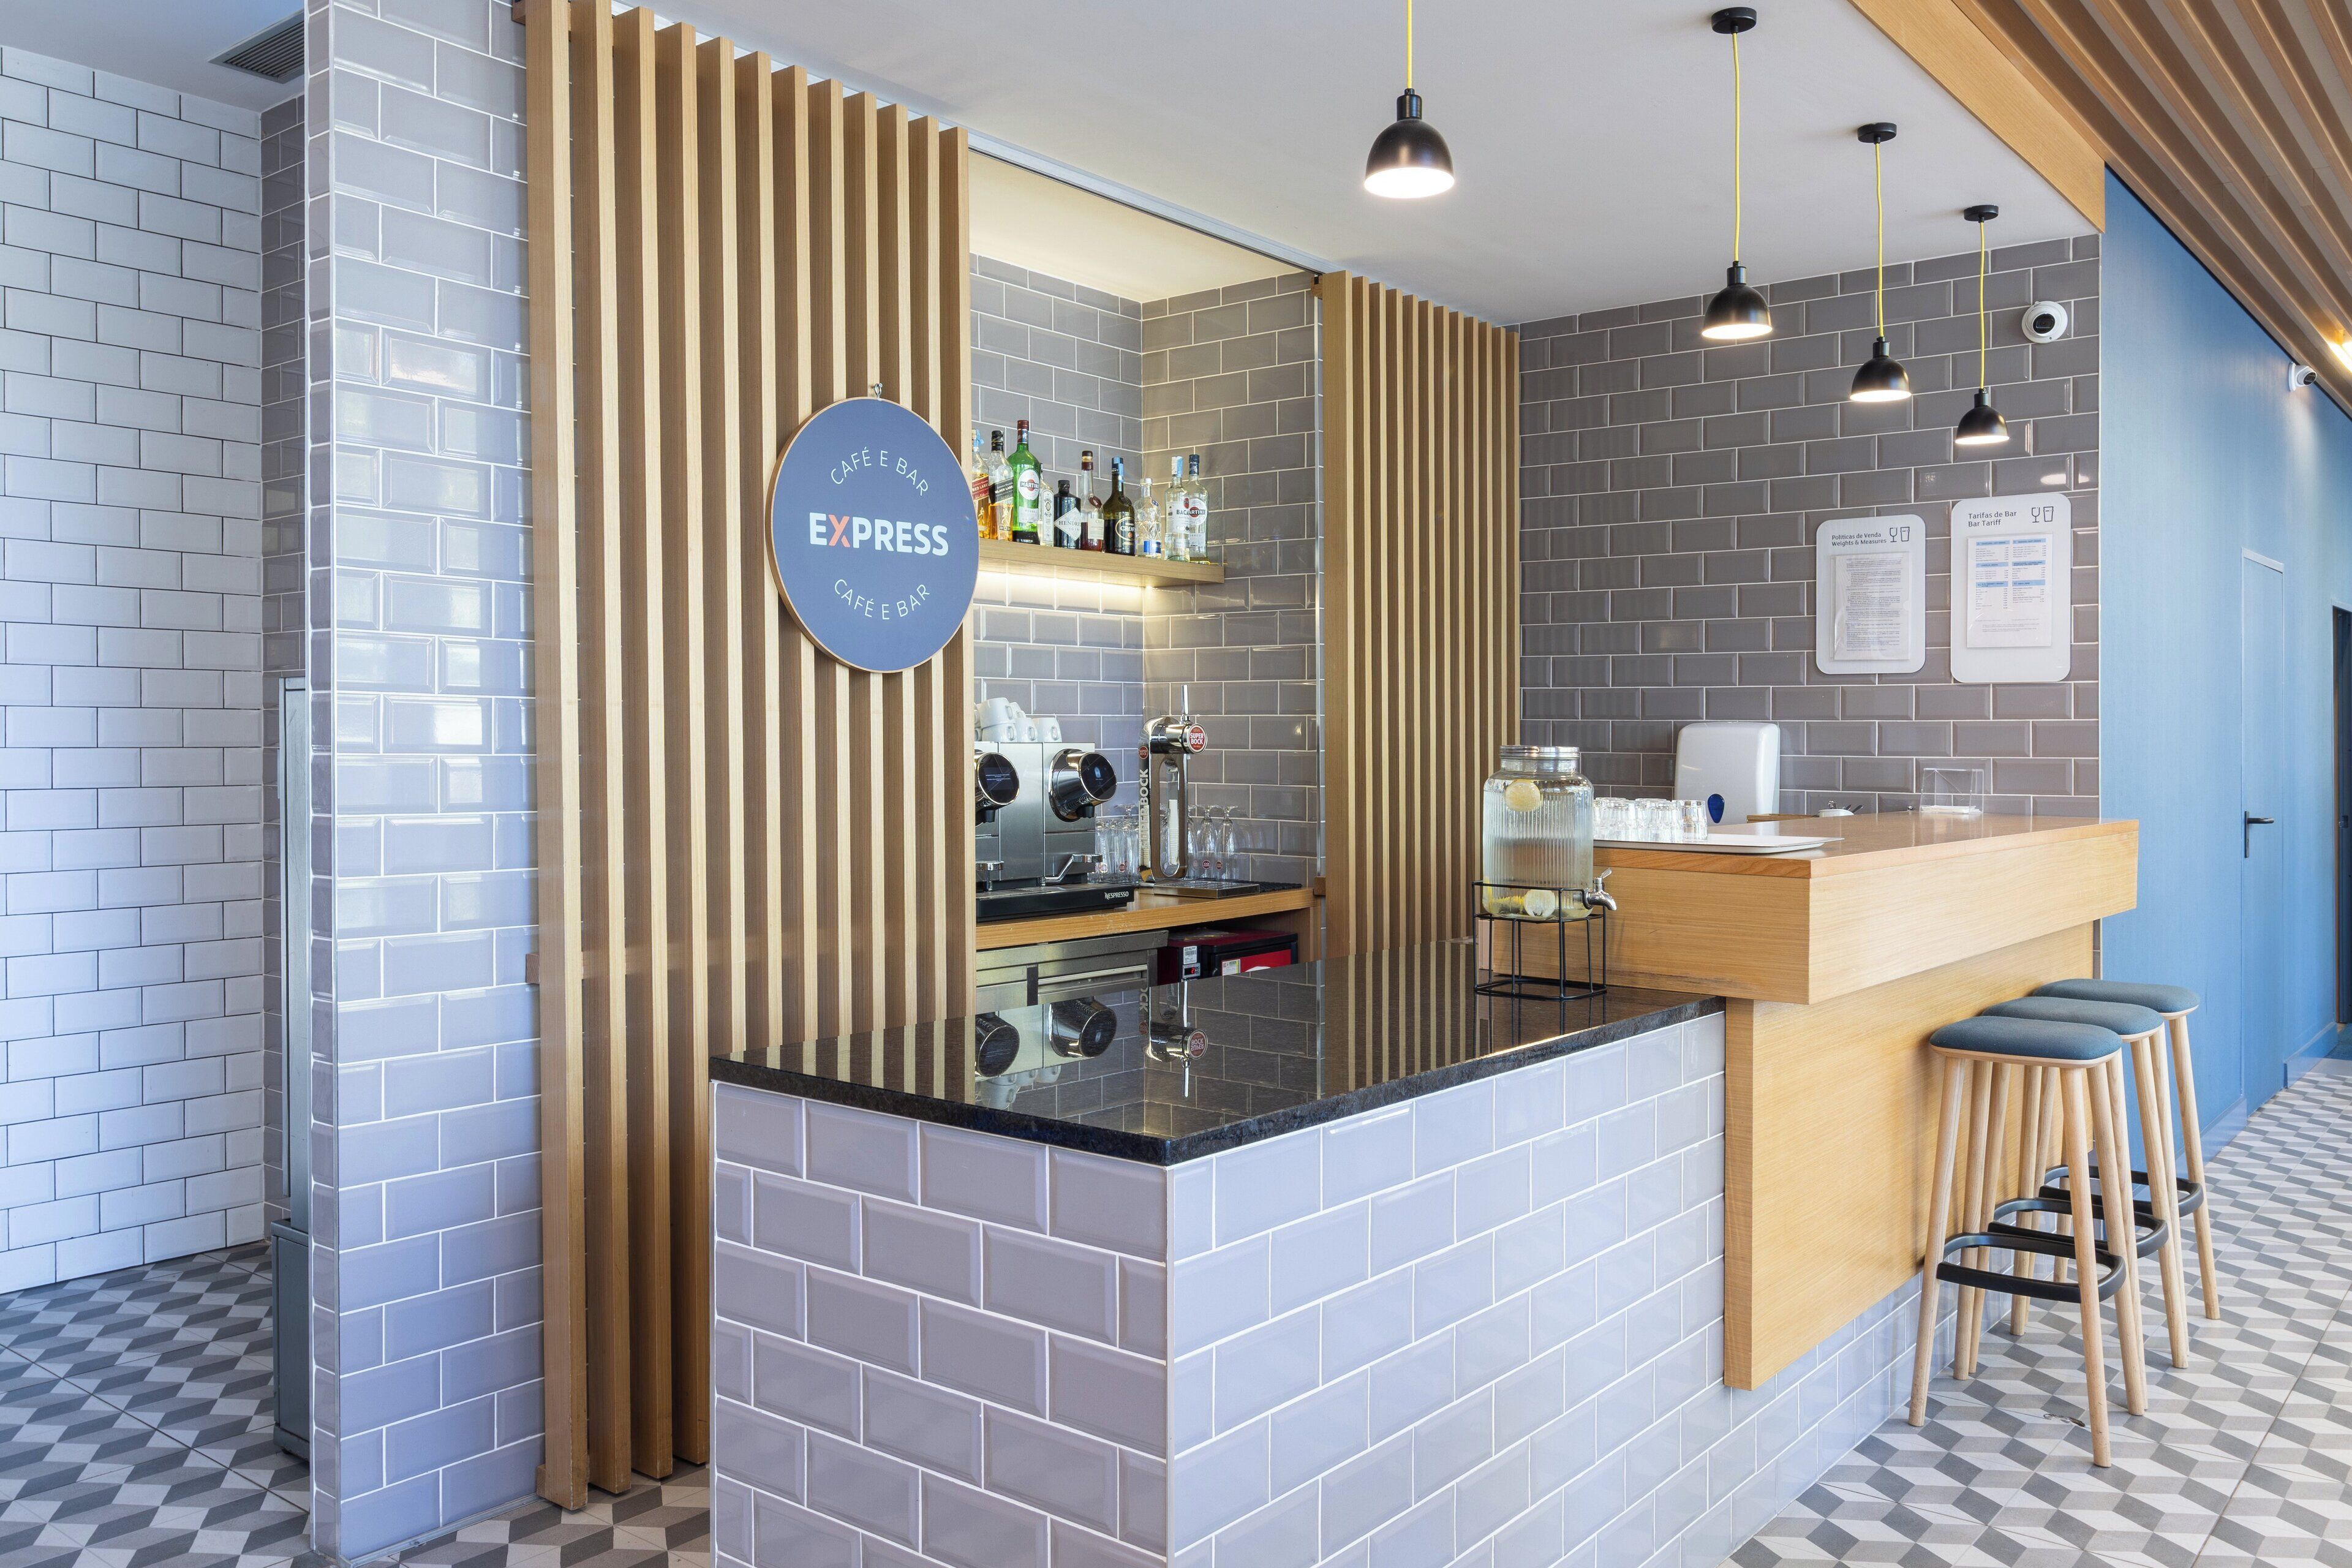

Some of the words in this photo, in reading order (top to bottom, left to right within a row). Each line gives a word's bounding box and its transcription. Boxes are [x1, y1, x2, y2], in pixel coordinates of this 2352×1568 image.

[831, 446, 872, 485] CAFÉ
[880, 450, 888, 467] E
[895, 457, 929, 497] BAR
[809, 512, 949, 556] EXPRESS
[834, 579, 875, 618] CAFÉ
[881, 604, 890, 620] E
[896, 584, 930, 617] BAR
[1139, 768, 1148, 806] BOCK
[1104, 891, 1129, 900] NESPRESSO
